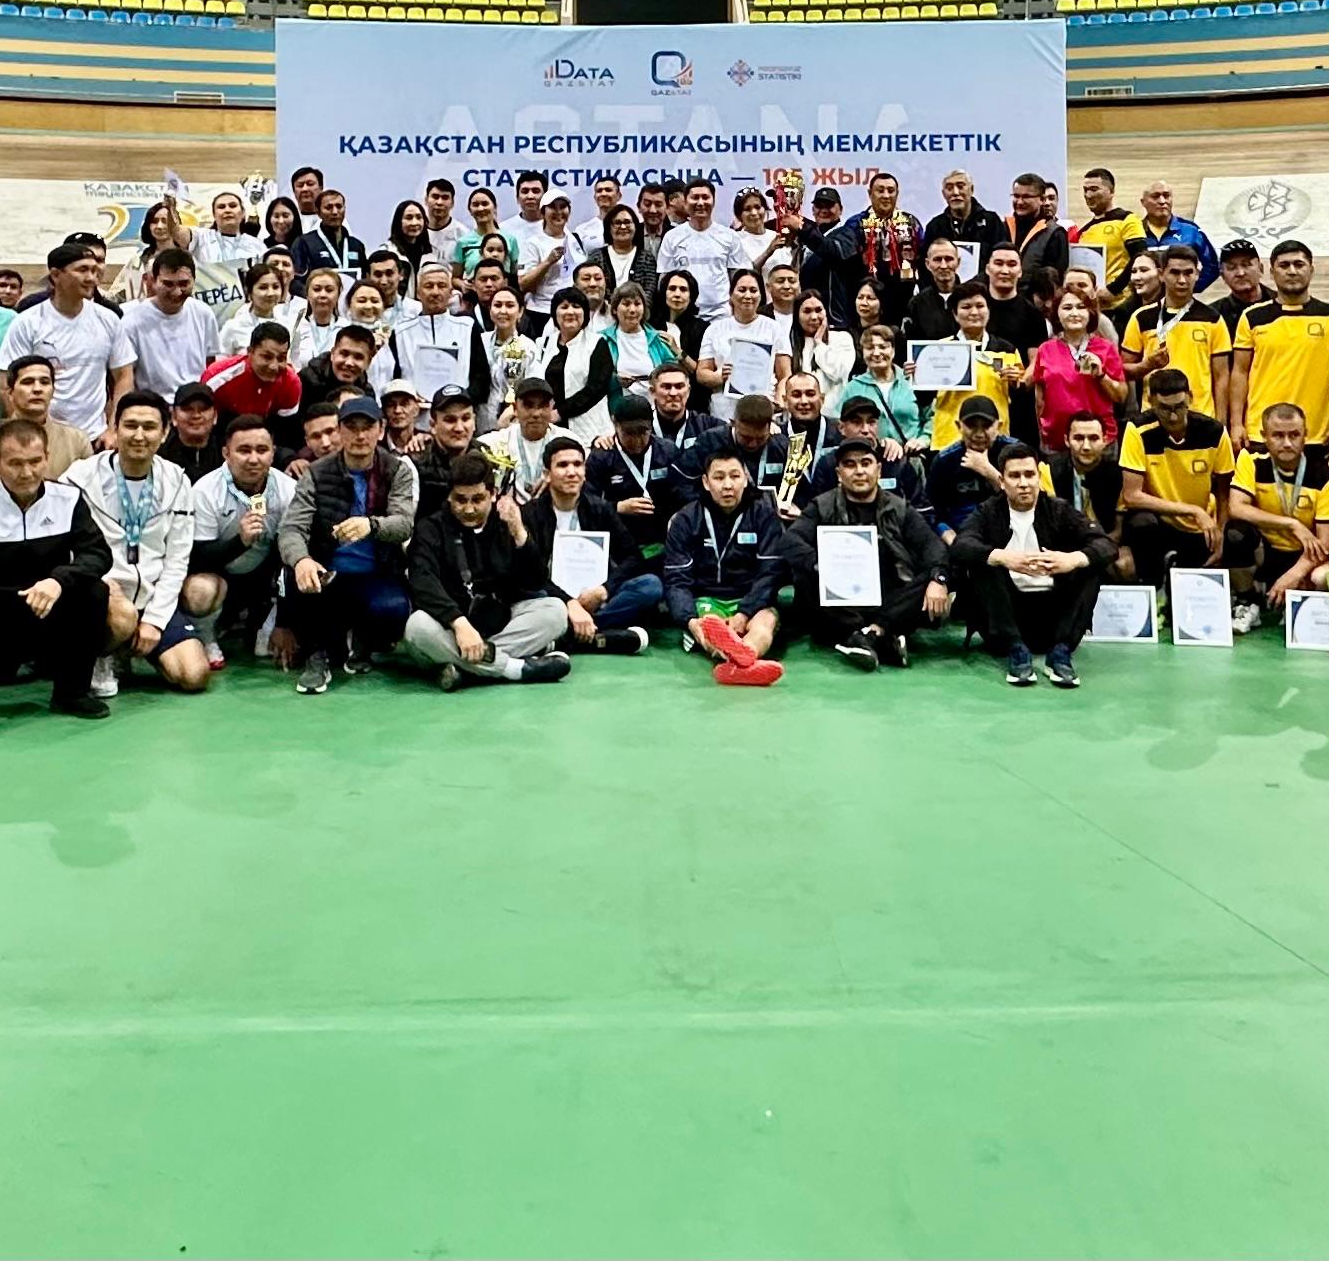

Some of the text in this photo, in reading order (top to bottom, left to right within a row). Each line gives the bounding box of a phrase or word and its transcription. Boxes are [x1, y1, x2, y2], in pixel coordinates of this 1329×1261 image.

[339, 133, 1002, 157] ҚАЗАҚСТАН РЕСПУБЛИКАСЫНЫҢ МЕМЛЕКЕТТІК
[463, 168, 724, 187] СТАСТИКАСЫНА
